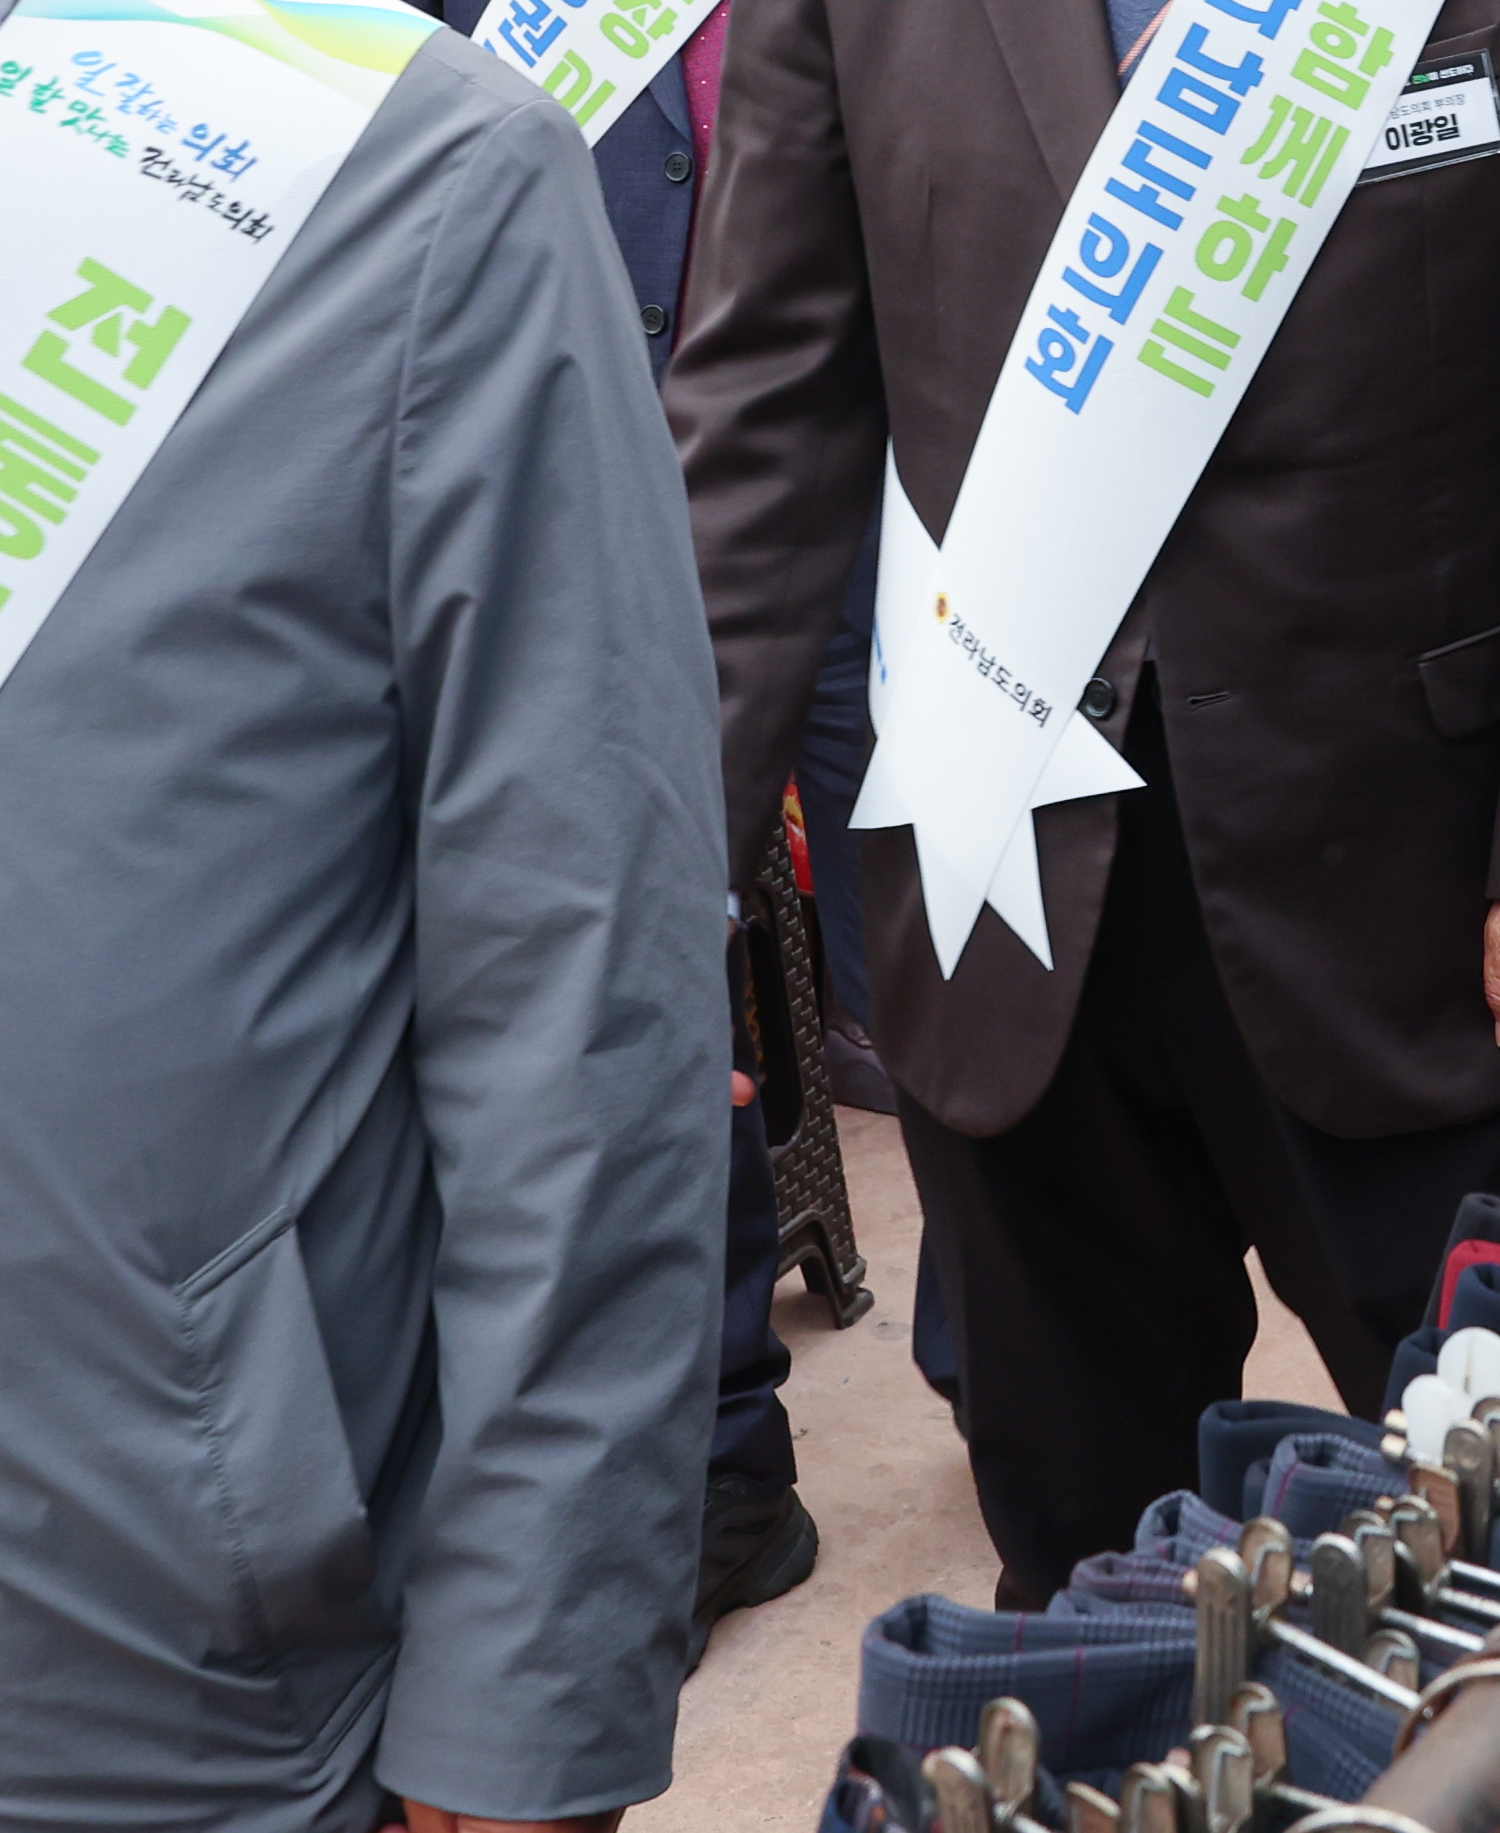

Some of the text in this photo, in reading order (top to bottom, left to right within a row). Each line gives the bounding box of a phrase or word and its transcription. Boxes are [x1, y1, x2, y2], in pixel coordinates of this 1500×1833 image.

[114, 71, 180, 134] 잘하는
[180, 123, 259, 182] 의회
[1385, 113, 1460, 151] 이광일
[137, 146, 276, 245] 전라남도의회
[1136, 0, 1395, 398] 함께하는
[950, 614, 1052, 728] 전라남도의회
